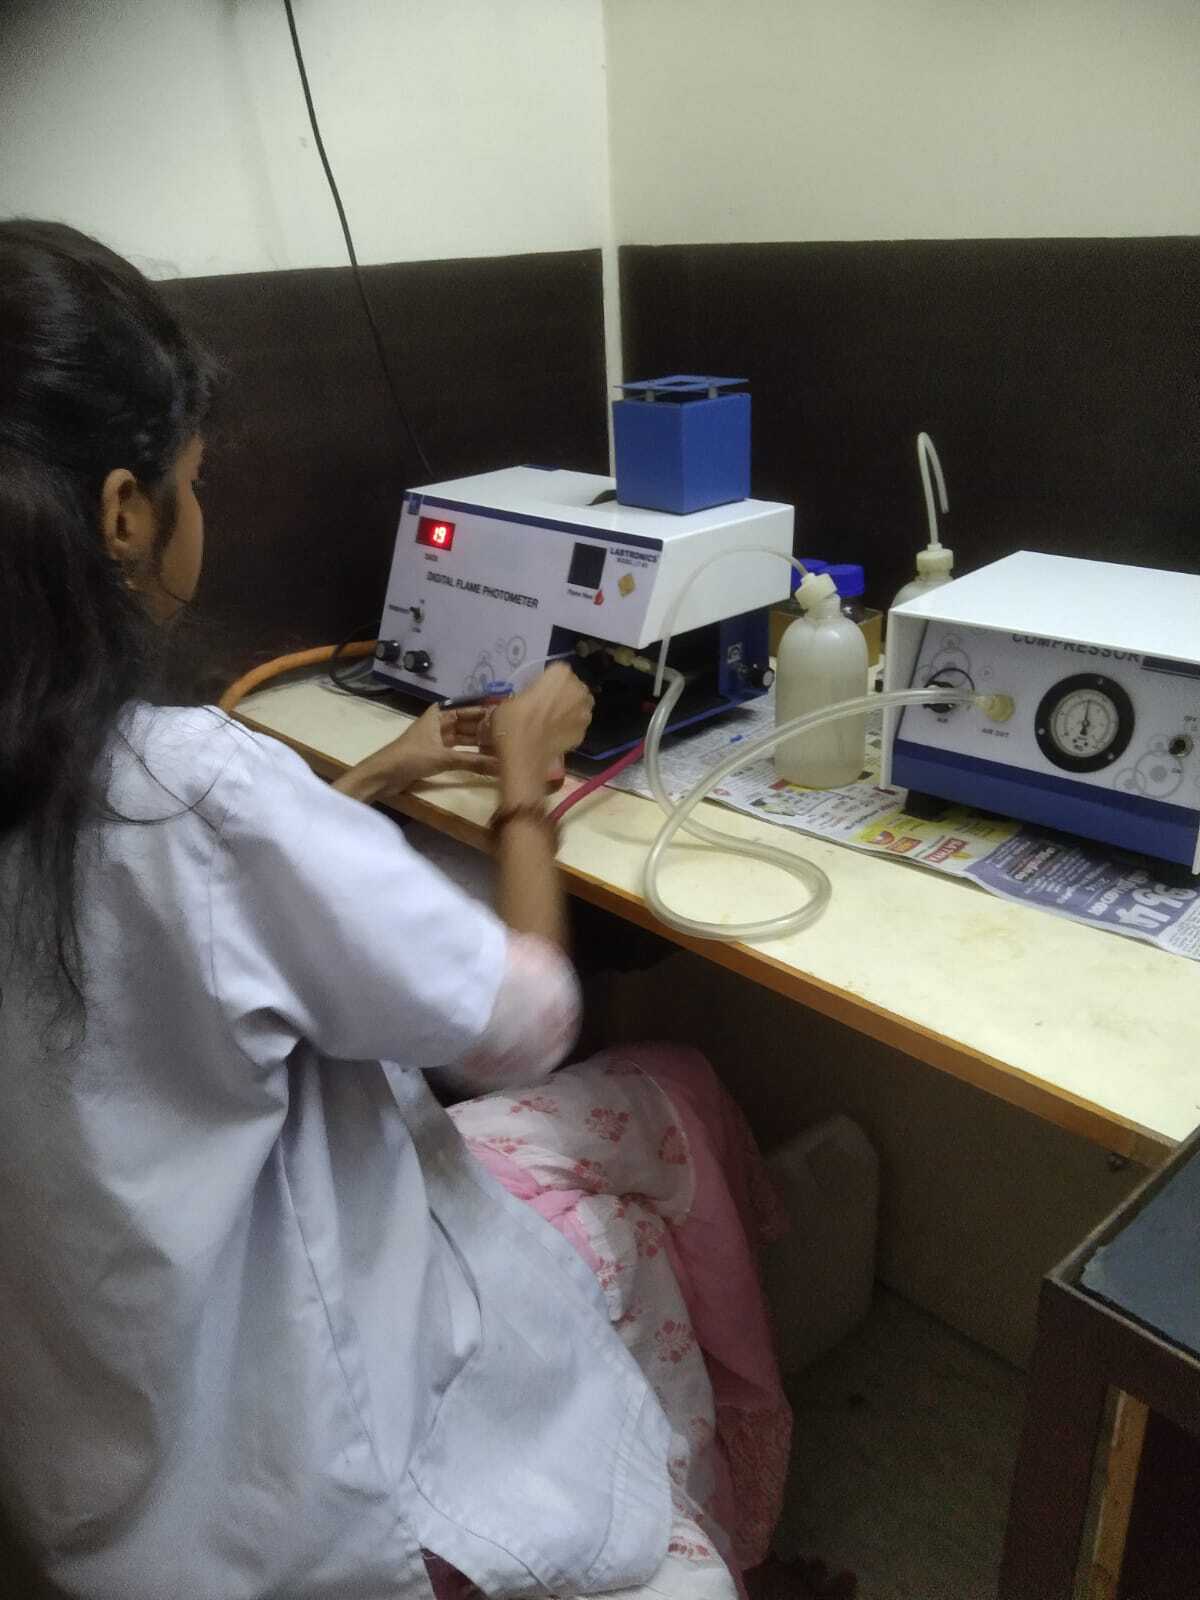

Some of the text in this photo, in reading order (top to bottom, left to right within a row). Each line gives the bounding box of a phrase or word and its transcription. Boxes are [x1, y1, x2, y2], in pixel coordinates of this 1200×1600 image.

[610, 547, 658, 563] LABTRONICS
[426, 571, 539, 608] DIGITAL FLAME PHOTOMETER
